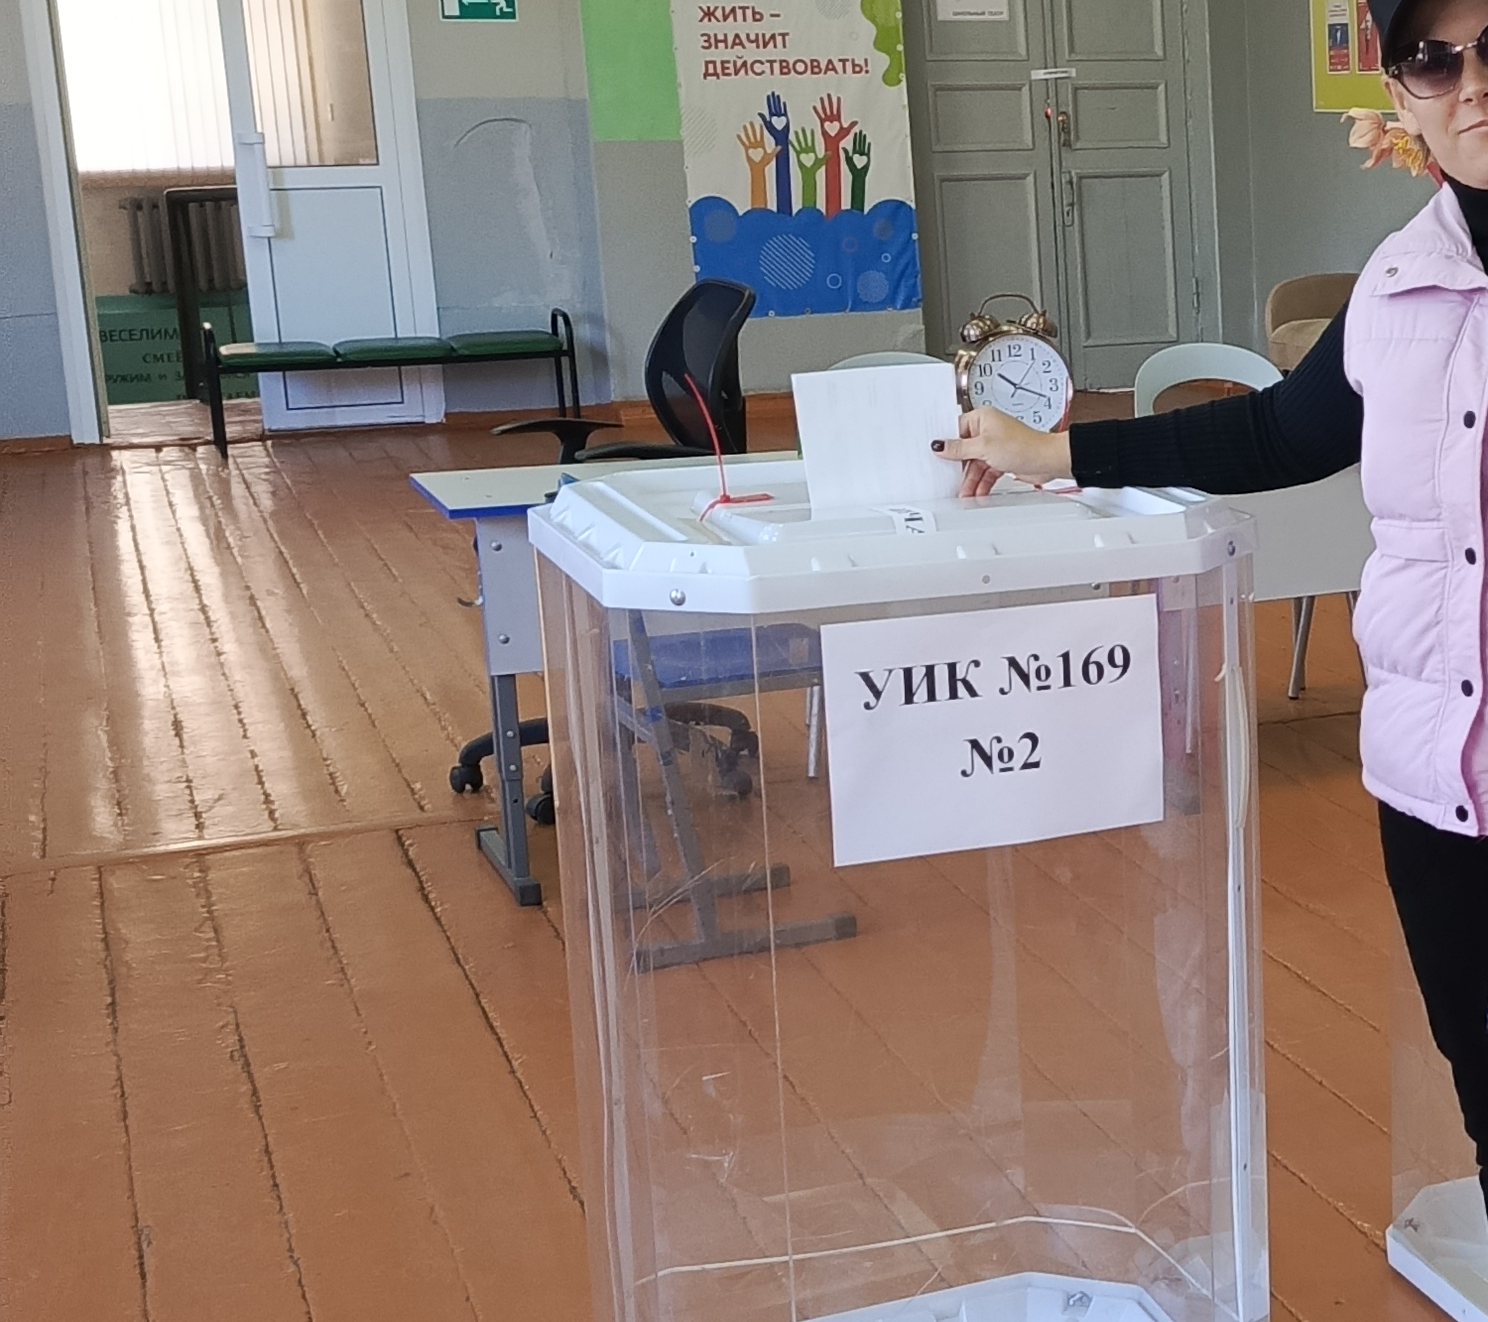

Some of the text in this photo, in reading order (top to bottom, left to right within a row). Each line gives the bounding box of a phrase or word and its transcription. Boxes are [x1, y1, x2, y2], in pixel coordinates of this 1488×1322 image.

[698, 6, 764, 22] ЖИТЬ
[700, 32, 790, 50] ЗНАЧИТ
[703, 55, 870, 80] ДЕЙСТВОВАТЬ!
[991, 349, 1002, 362] 11
[1007, 344, 1022, 357] 12
[1030, 348, 1036, 361] 1
[979, 363, 993, 377] 10
[1042, 360, 1052, 373] 2
[974, 381, 984, 395] 9
[1049, 378, 1059, 392] 3
[1033, 411, 1042, 424] 5
[855, 643, 1131, 711] УИК №169
[960, 731, 1042, 778] №2
